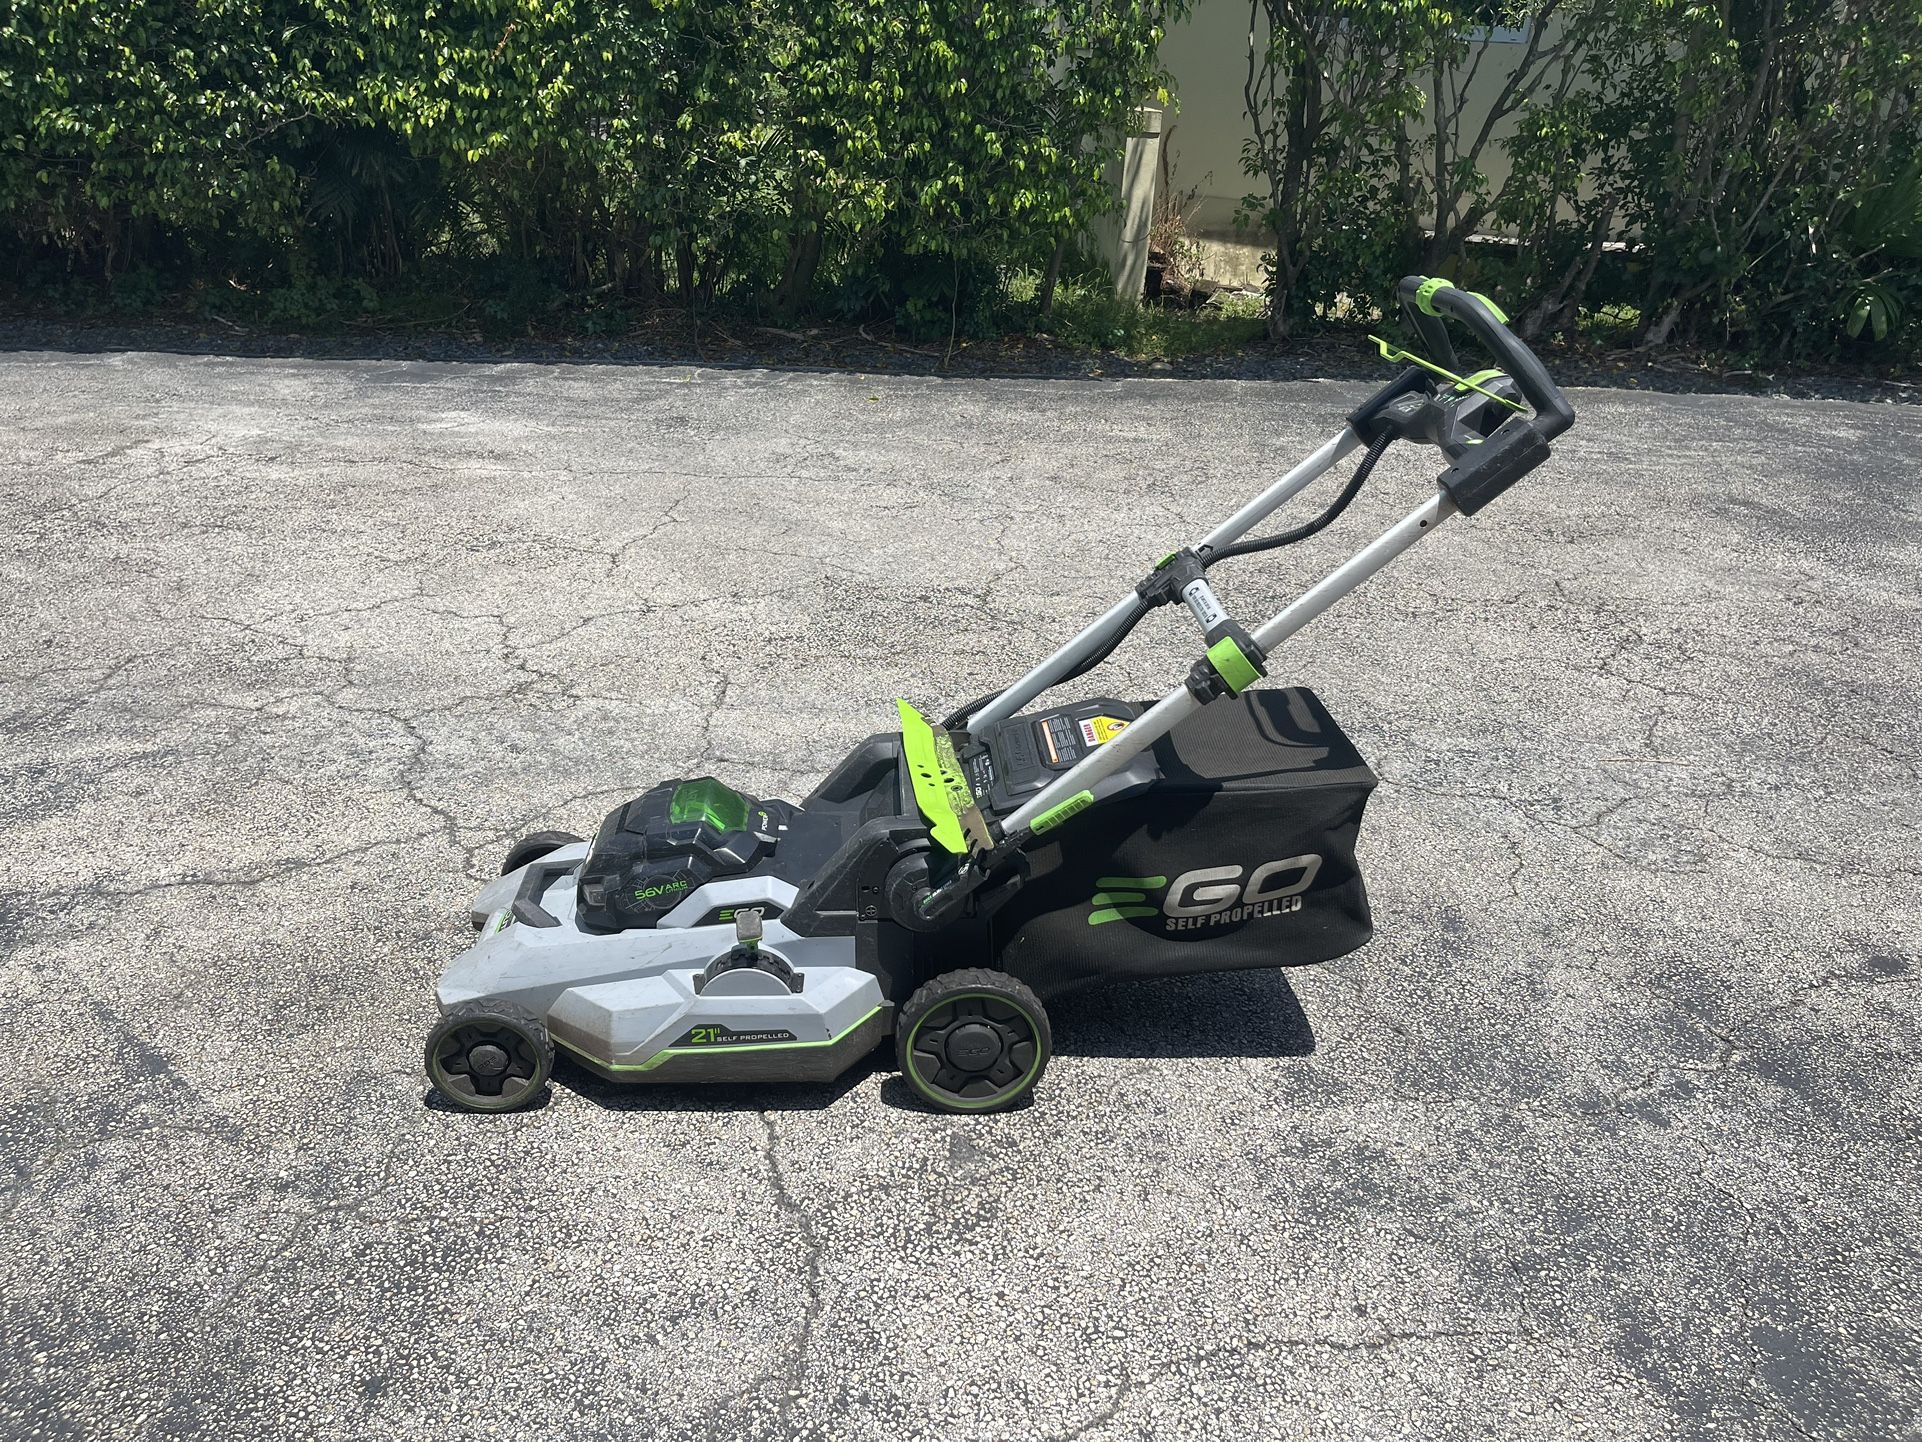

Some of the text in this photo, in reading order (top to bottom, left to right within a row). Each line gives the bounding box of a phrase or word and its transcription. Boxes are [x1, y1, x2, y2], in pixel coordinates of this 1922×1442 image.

[634, 880, 687, 900] 56V ARC
[1087, 853, 1323, 926] EGO
[1165, 895, 1302, 931] SELF PROPELLED
[691, 1027, 721, 1043] 21"
[739, 1032, 790, 1041] PROPELLED
